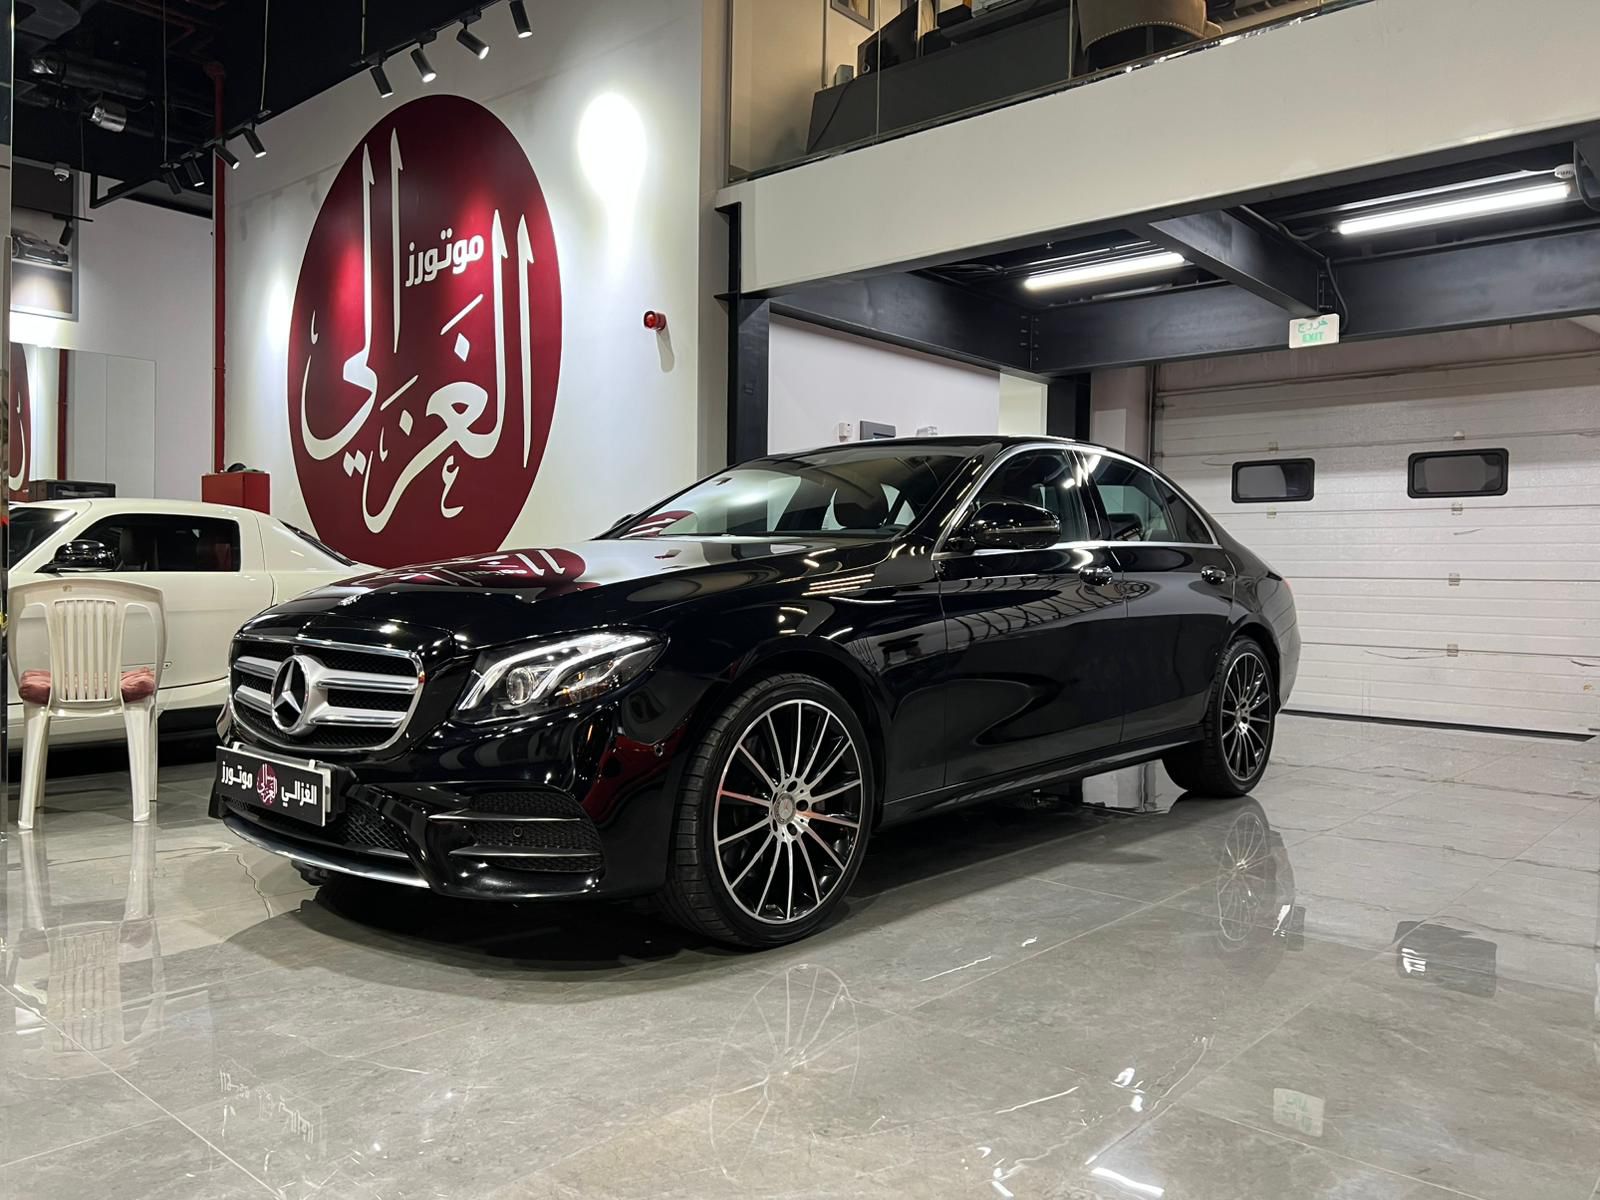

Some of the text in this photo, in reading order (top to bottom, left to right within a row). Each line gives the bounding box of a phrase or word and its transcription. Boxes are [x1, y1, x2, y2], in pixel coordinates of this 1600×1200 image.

[404, 228, 485, 288] موتورز
[1302, 332, 1325, 343] EXIT
[221, 760, 318, 808] الغزالي موتورز
